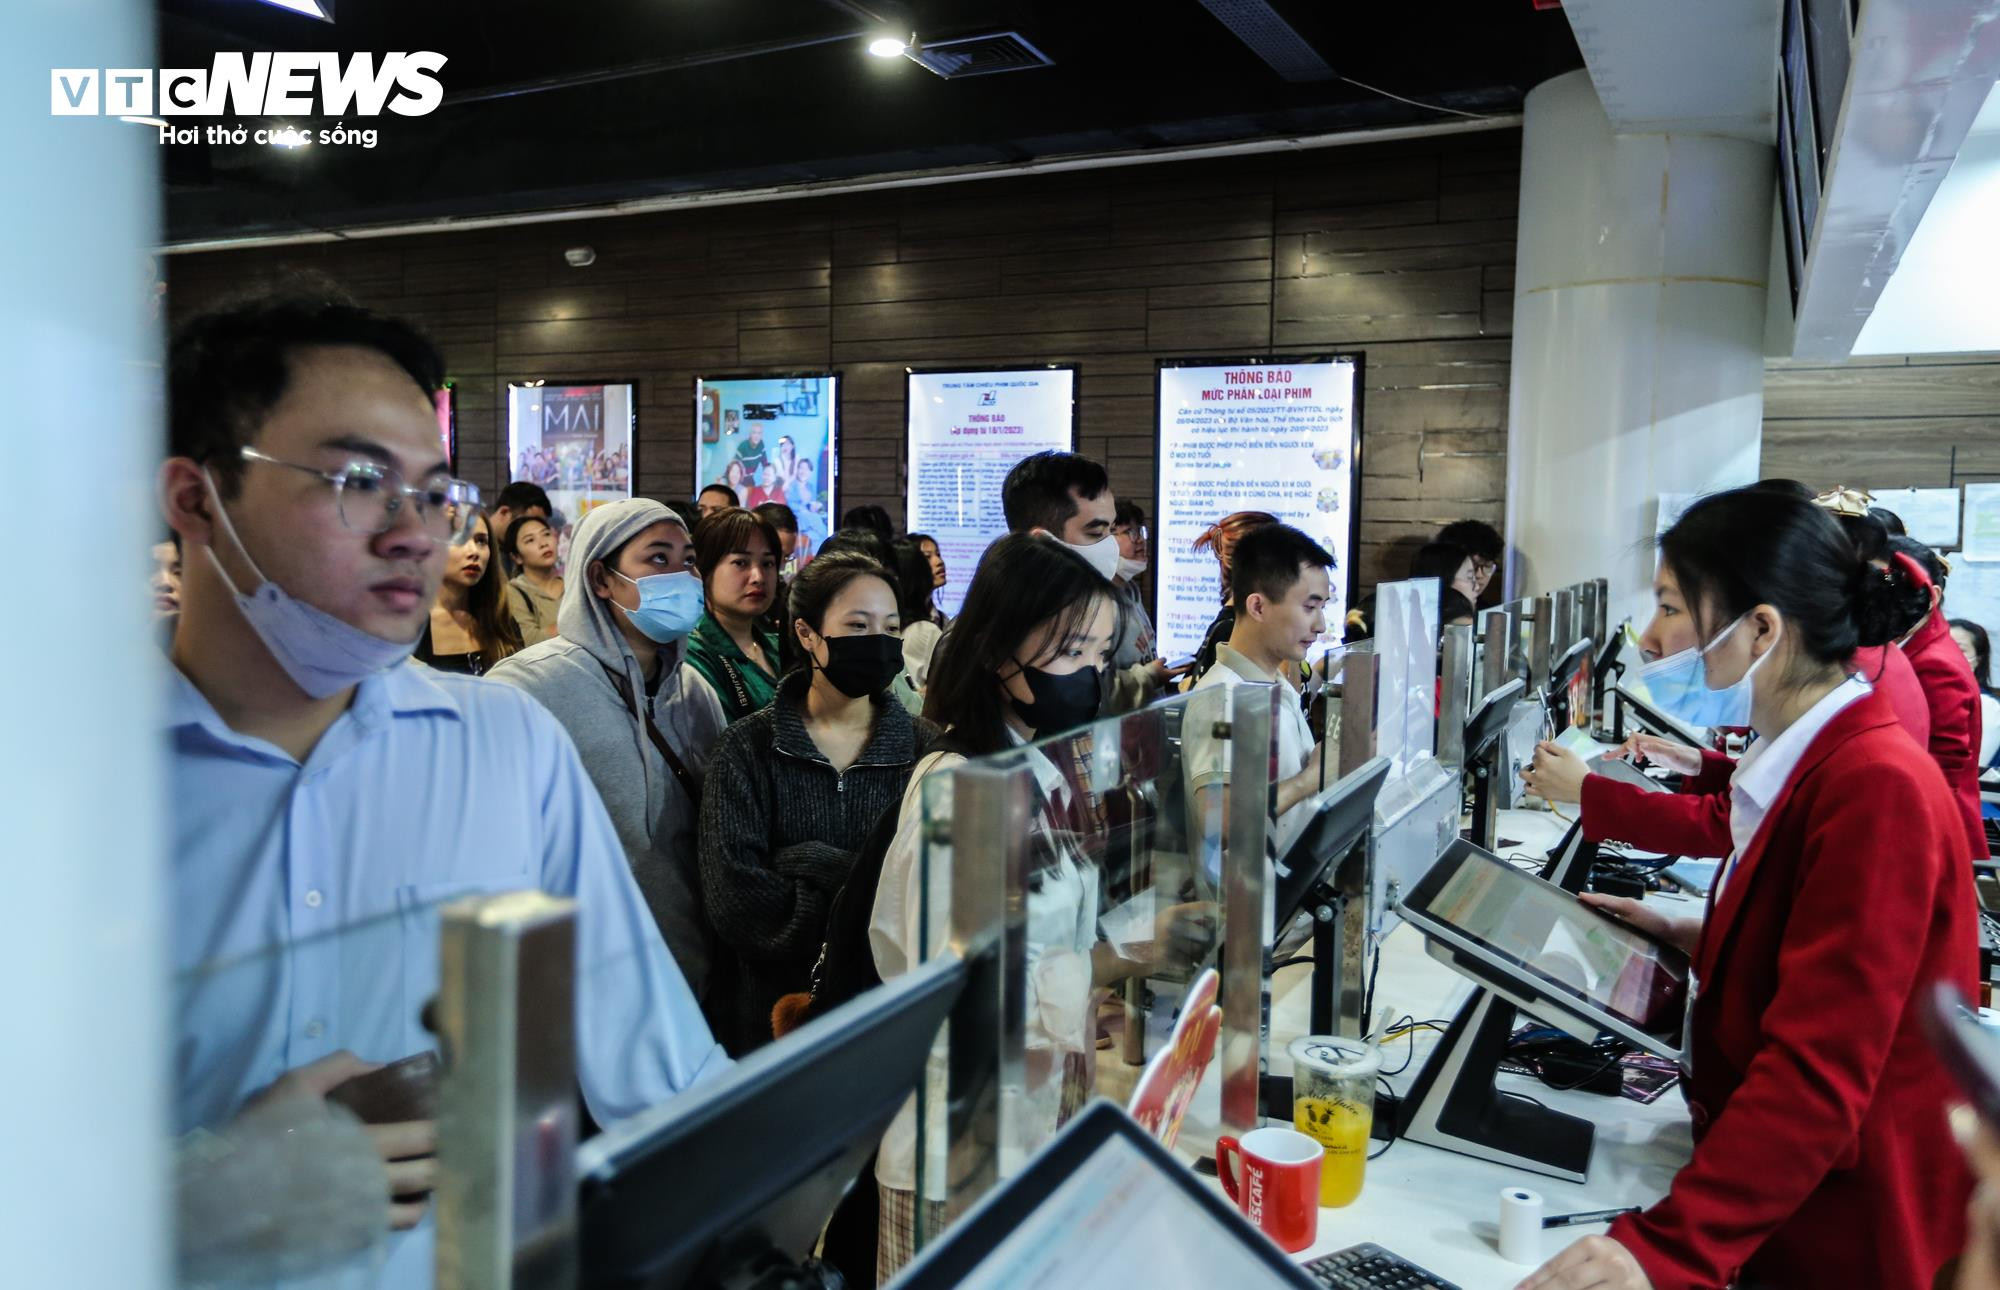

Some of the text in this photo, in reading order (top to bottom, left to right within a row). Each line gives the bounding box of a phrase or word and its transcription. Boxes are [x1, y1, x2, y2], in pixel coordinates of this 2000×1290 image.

[1225, 369, 1292, 384] THÔNG BÁO
[1284, 388, 1312, 399] PHIM
[544, 403, 600, 432] MAI
[1246, 1163, 1263, 1227] ESCAFÉ
